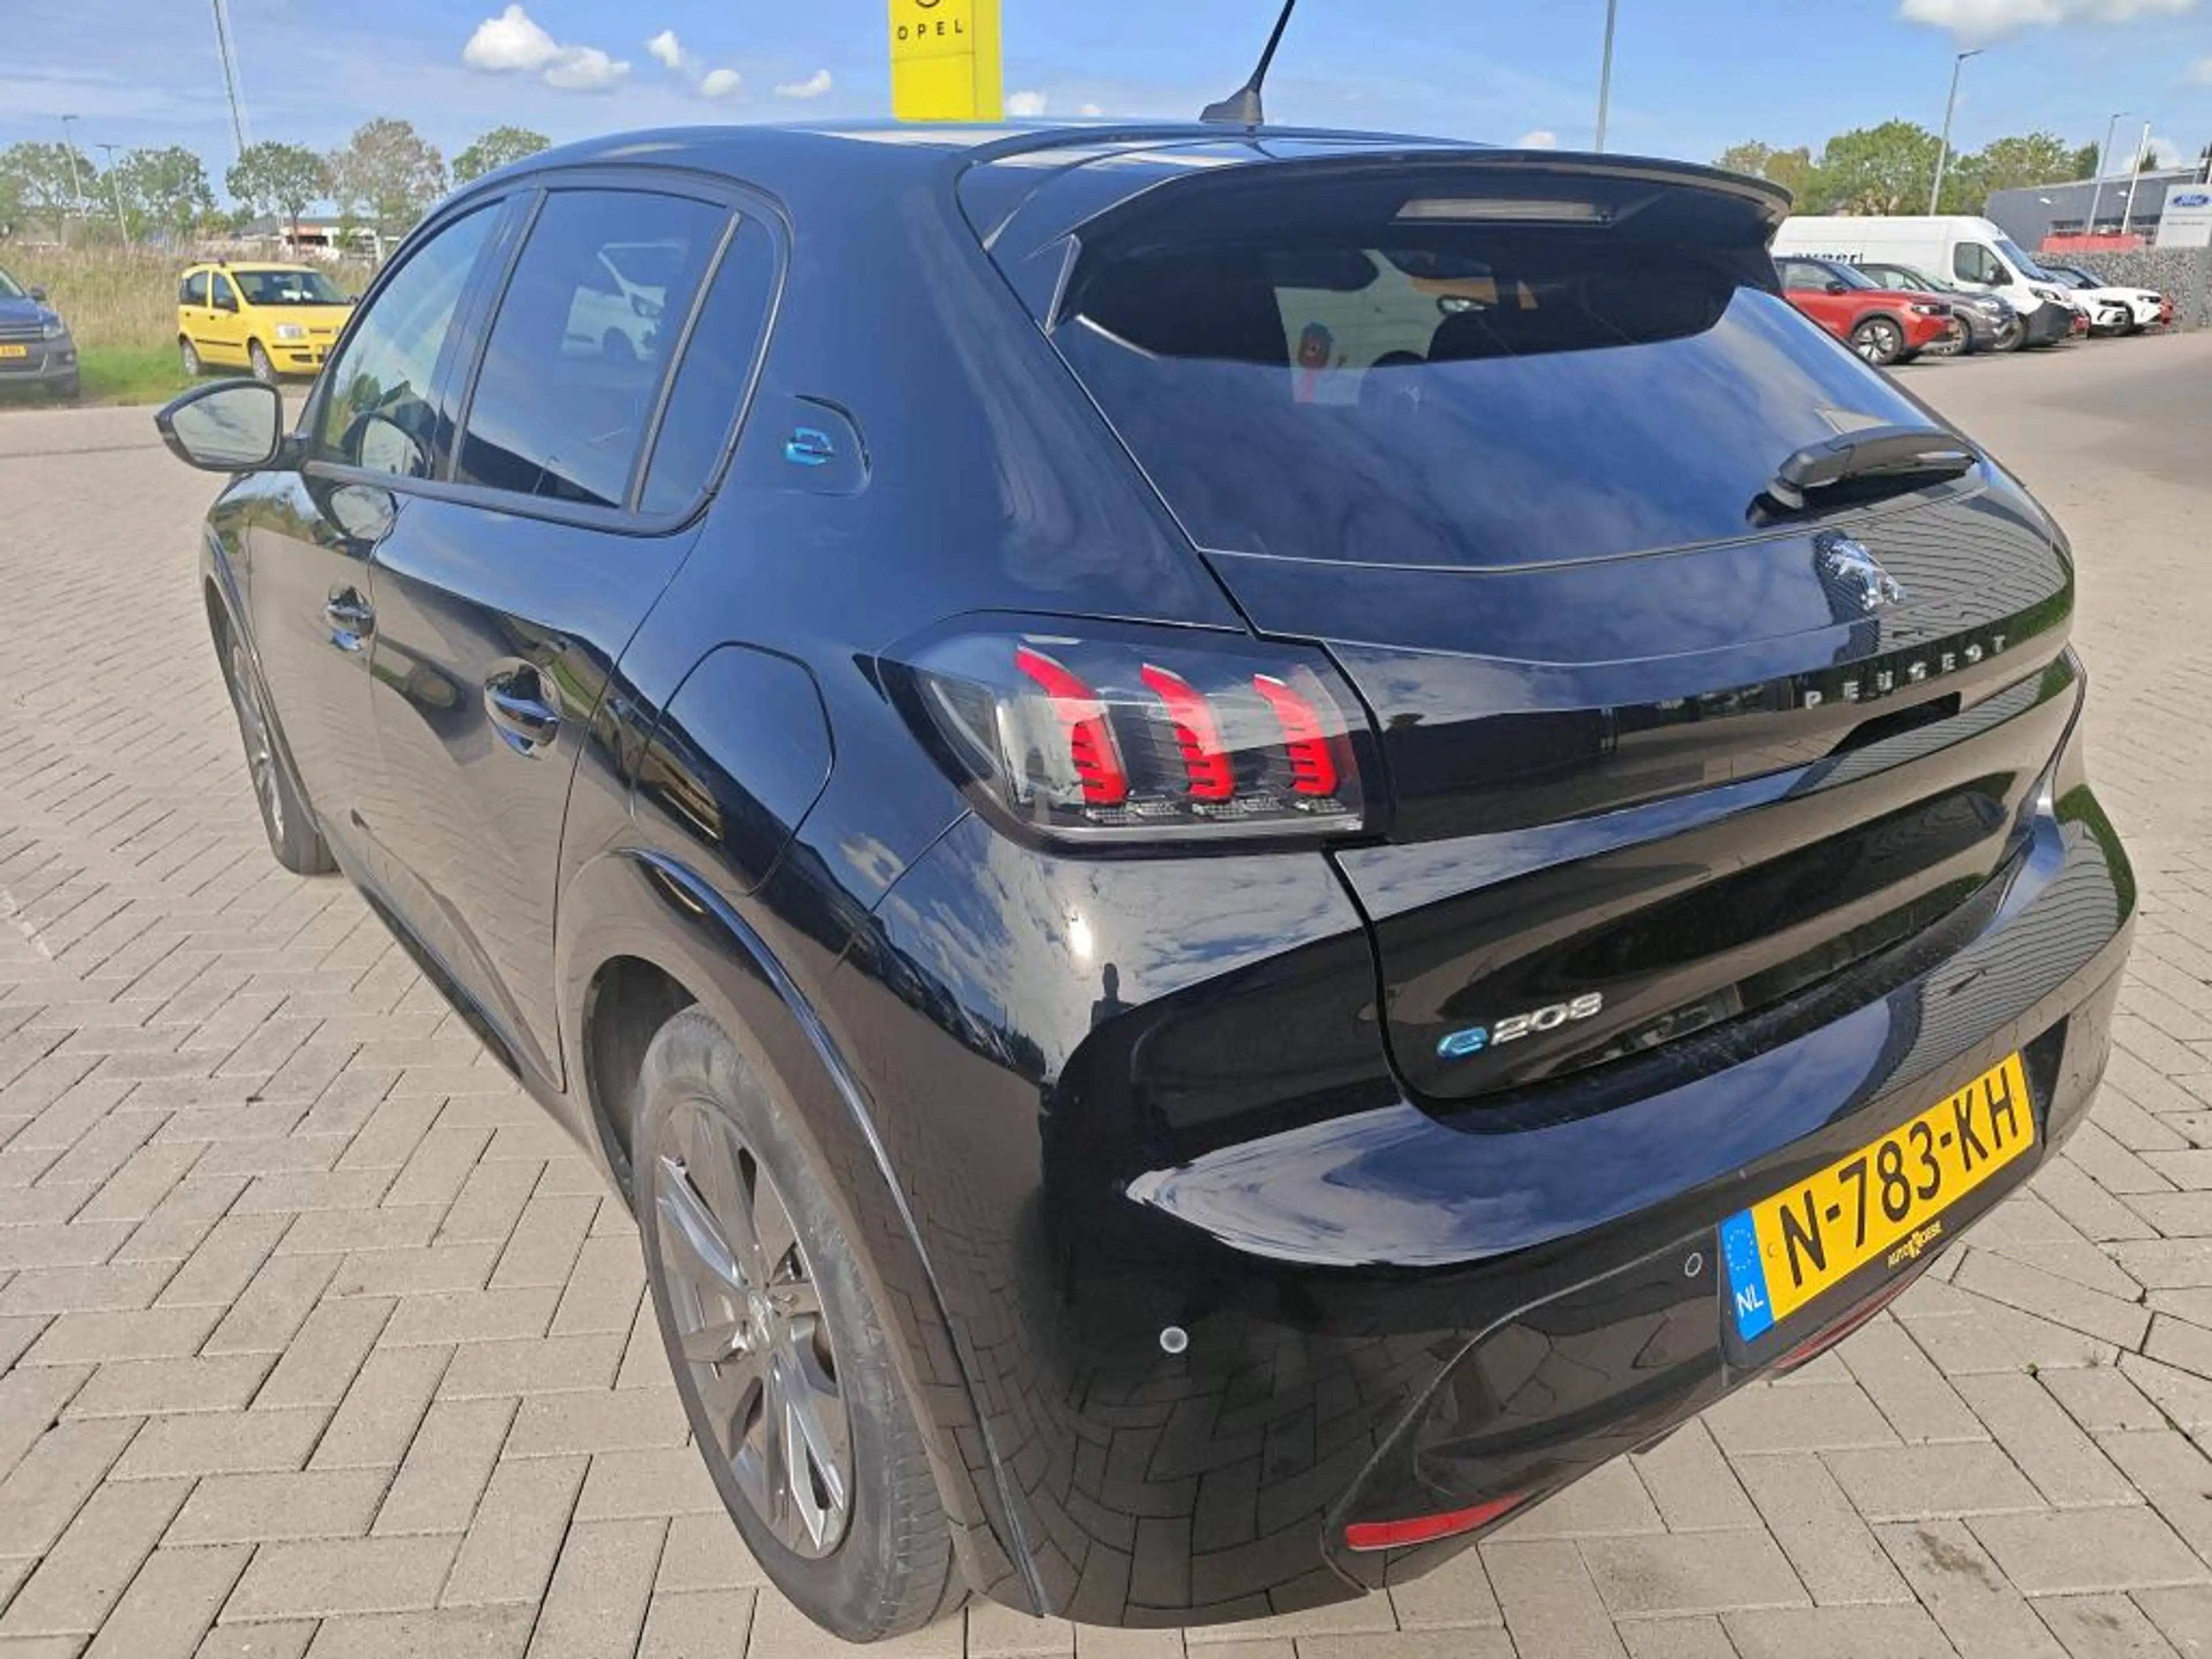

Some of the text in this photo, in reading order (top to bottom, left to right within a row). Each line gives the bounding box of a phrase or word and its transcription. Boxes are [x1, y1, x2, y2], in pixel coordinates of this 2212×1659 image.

[897, 20, 963, 40] OPEL
[1805, 635, 2006, 710] PEUGEOT
[1779, 1066, 2018, 1288] N-783-KH
[1736, 1284, 1764, 1317] NL
